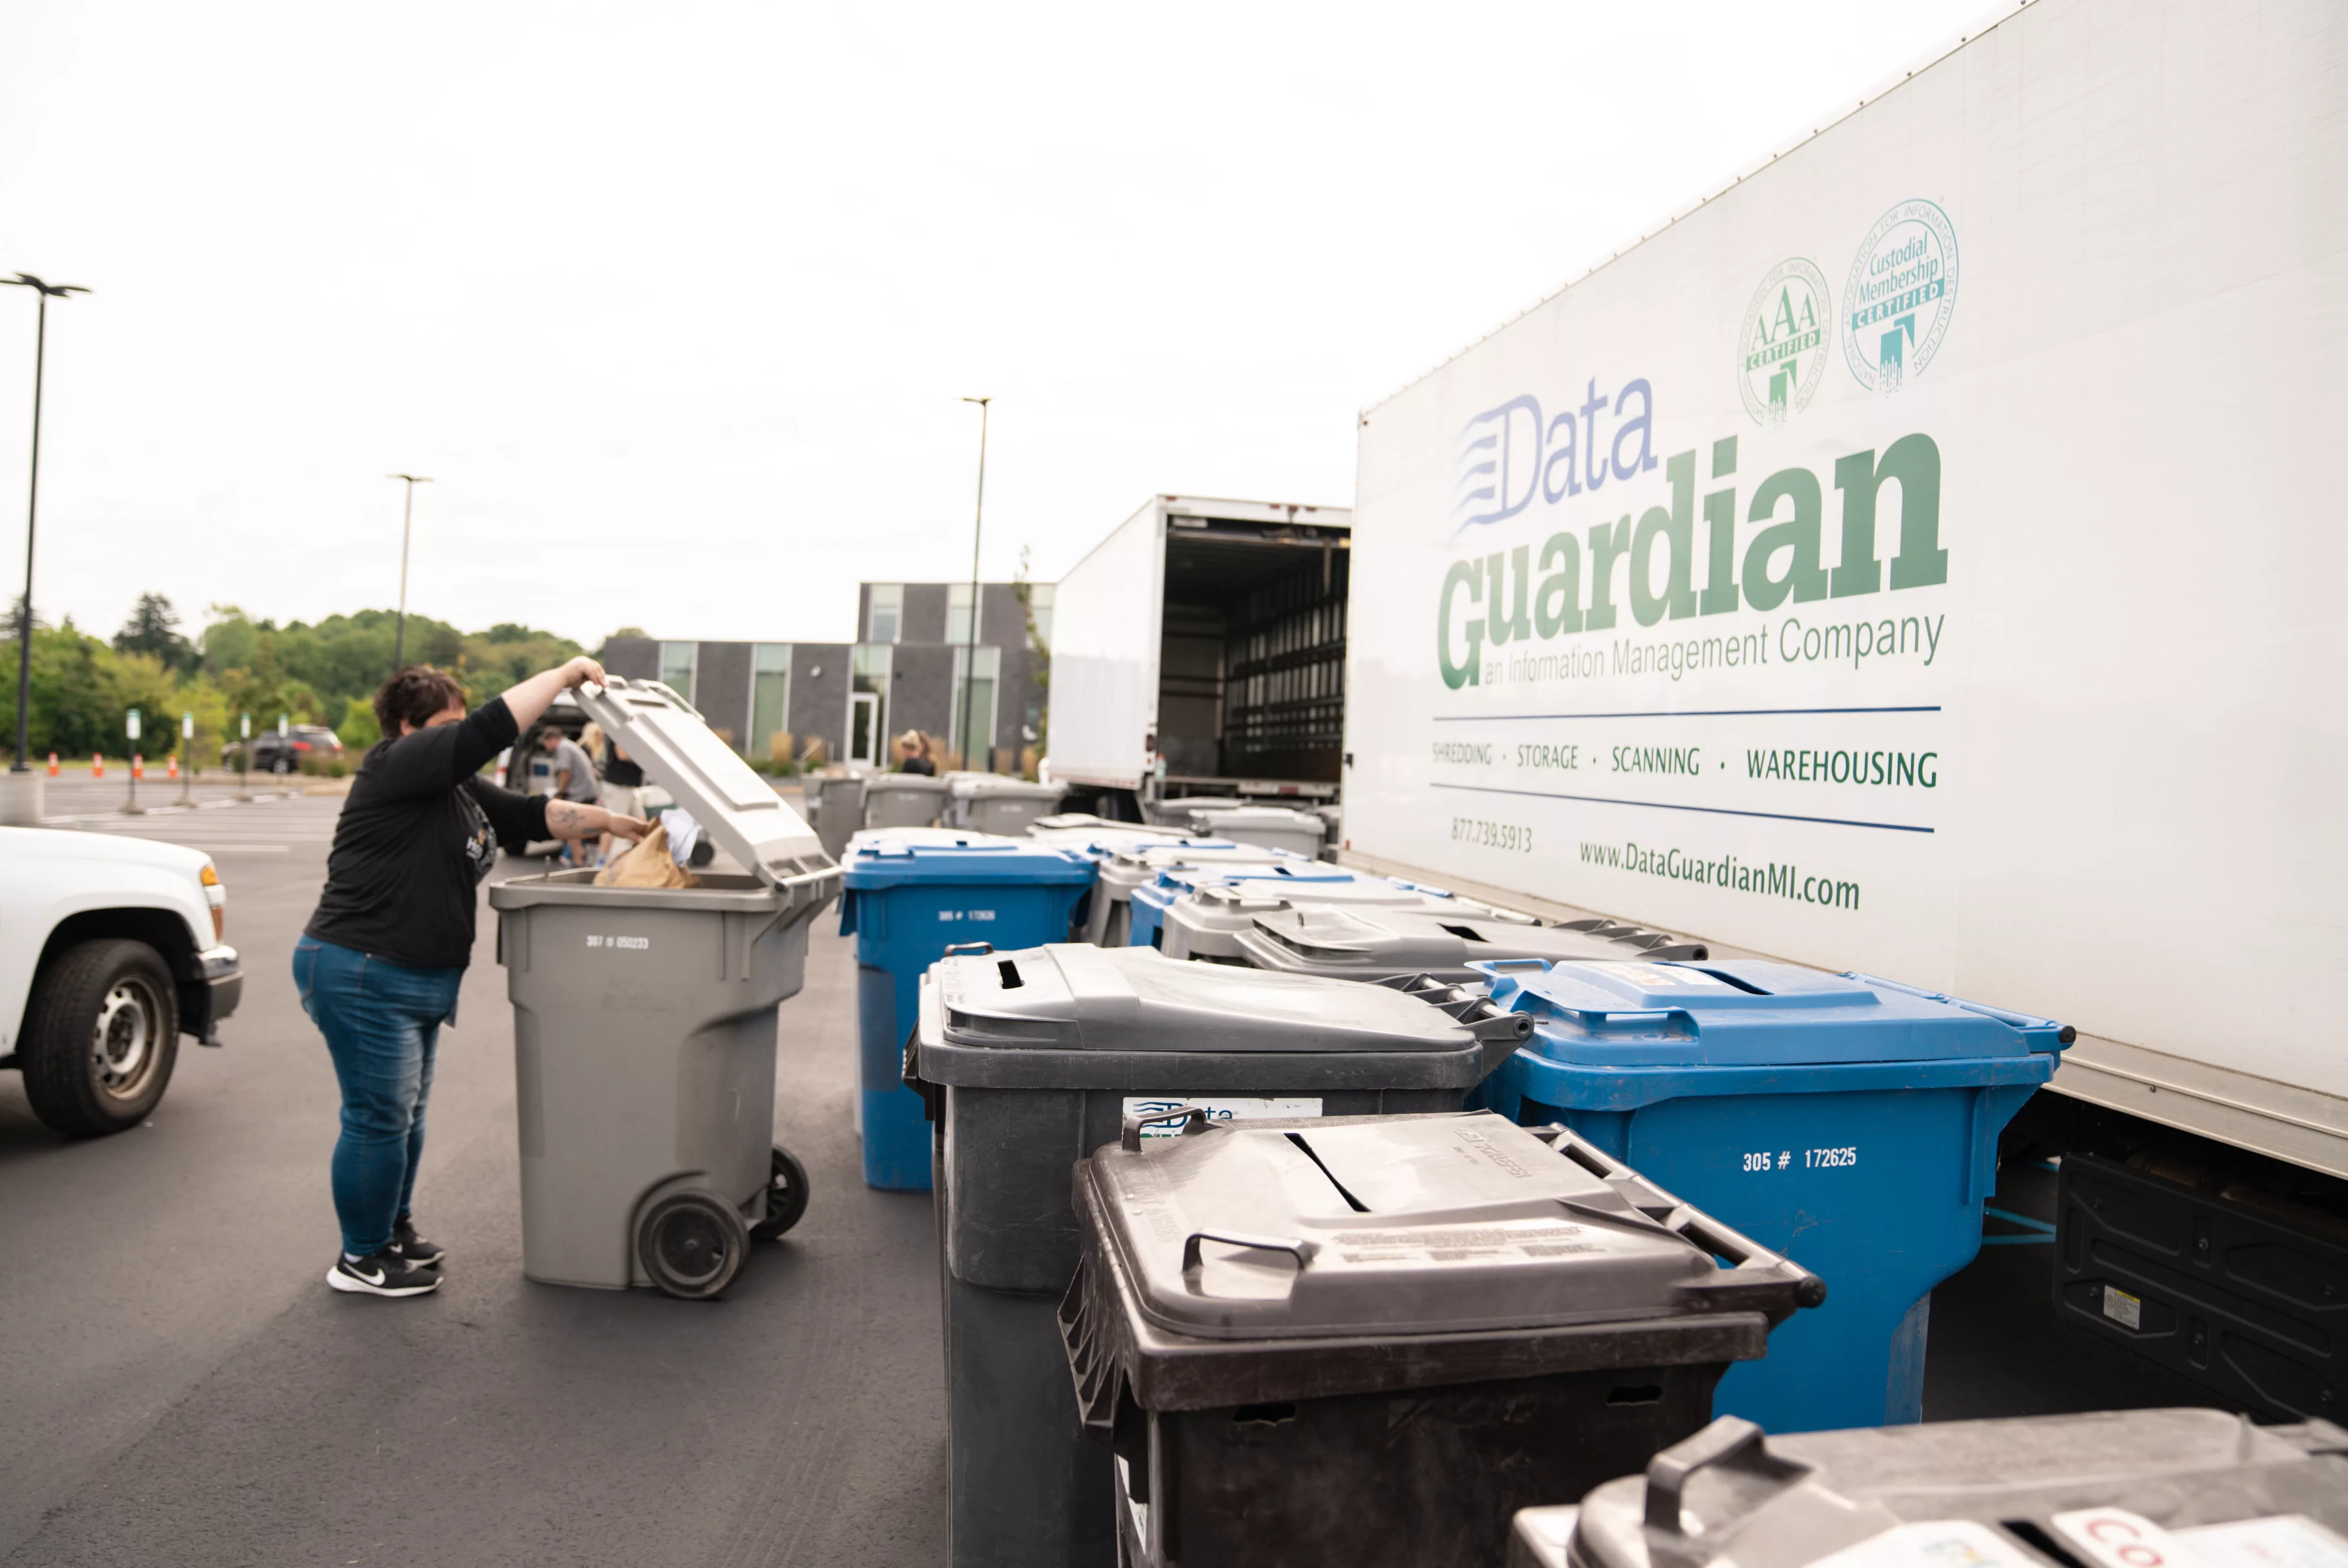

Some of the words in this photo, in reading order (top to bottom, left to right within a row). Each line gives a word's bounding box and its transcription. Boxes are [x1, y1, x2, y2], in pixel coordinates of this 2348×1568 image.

[1880, 210, 1899, 232] FOR
[1903, 204, 1954, 261] INFORMATION
[1870, 230, 1928, 276] Custodial
[1857, 282, 1939, 327] CERTIFIED
[1859, 255, 1939, 306] Membership
[1751, 284, 1817, 352] AAA
[1914, 267, 1955, 370] DESTRUCTION
[1749, 332, 1816, 370] CERTIFIED
[1456, 376, 1658, 532] Data
[1438, 434, 1949, 690] Guardian
[1485, 659, 1502, 685] an
[1508, 643, 1604, 683] Information
[1613, 623, 1768, 681] Management
[1779, 614, 1945, 669] Company
[1432, 741, 1492, 765] SHREDDING
[1517, 745, 1578, 769] STORAGE
[1612, 746, 1700, 776] SCANNING
[1747, 749, 1938, 788] WAREHOUSING
[1451, 817, 1532, 853] 877.739.5913
[1580, 840, 1860, 910] www.DataGuardianMI.com
[1133, 1101, 1233, 1128] Dta
[1743, 1152, 1772, 1172] 305
[1777, 1151, 1791, 1169] #
[1805, 1147, 1857, 1168] 172625
